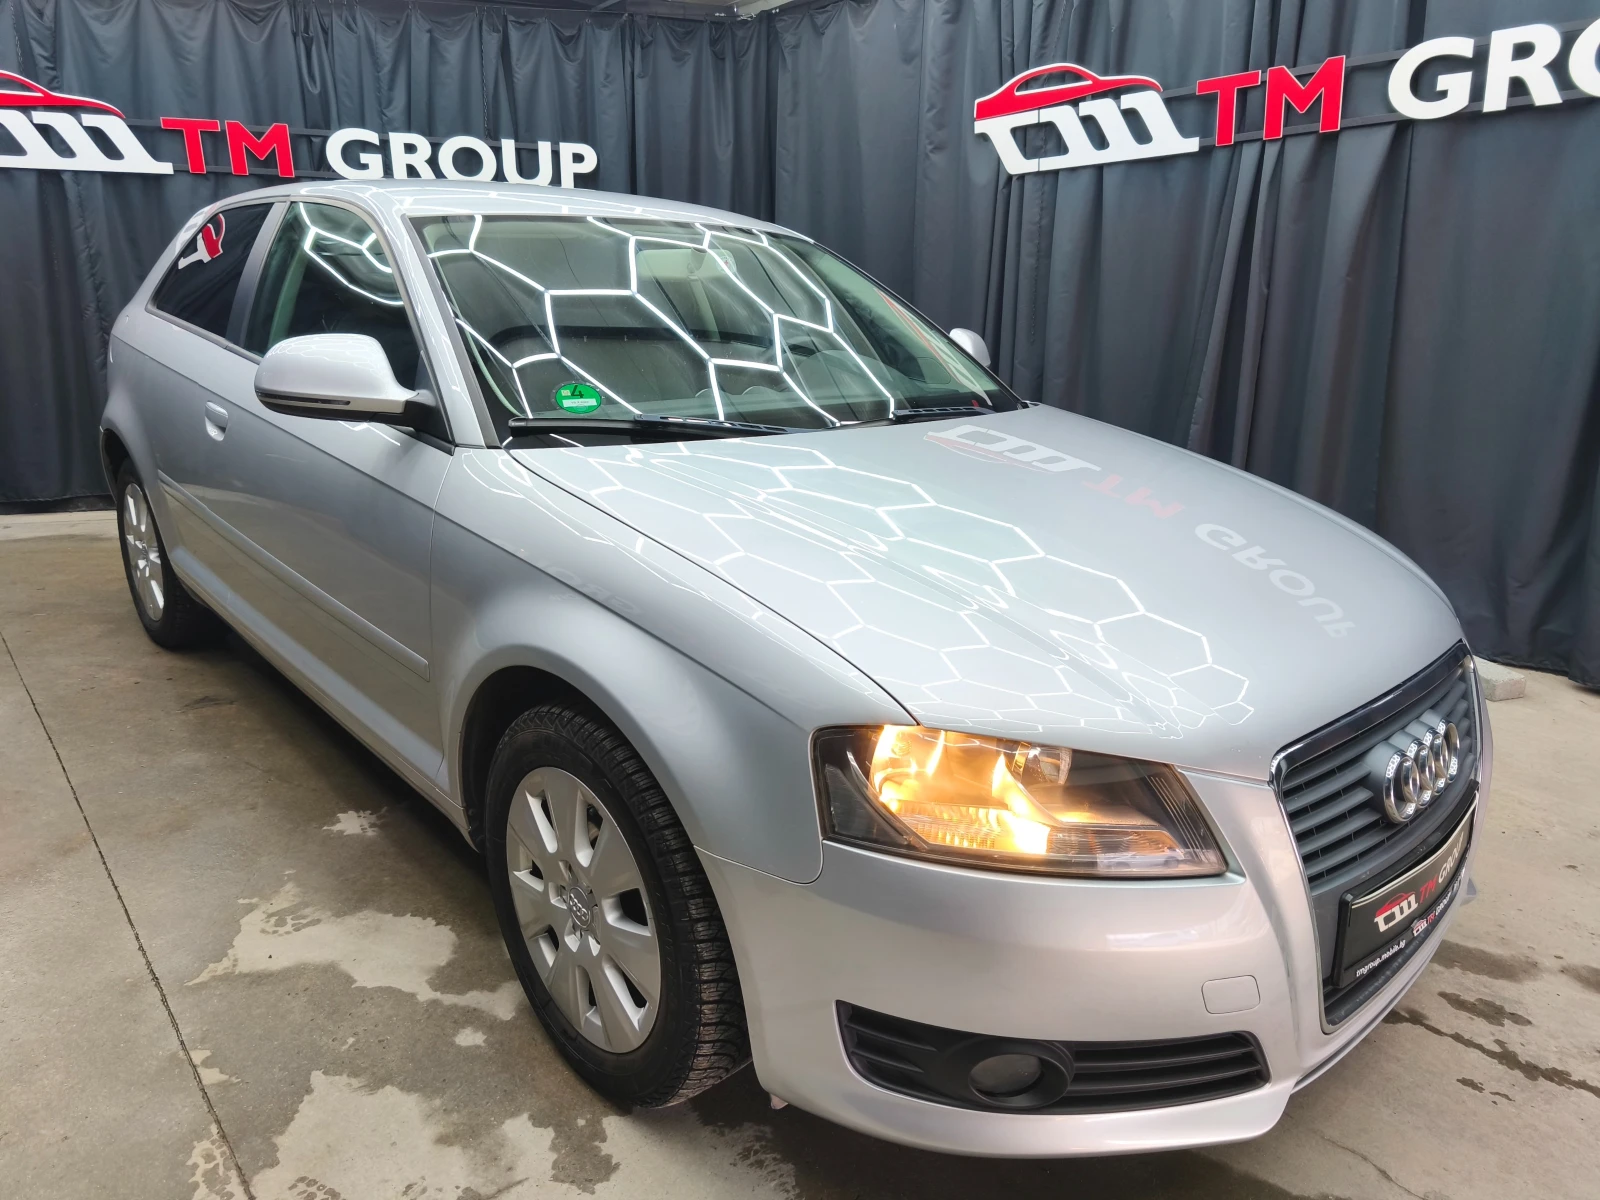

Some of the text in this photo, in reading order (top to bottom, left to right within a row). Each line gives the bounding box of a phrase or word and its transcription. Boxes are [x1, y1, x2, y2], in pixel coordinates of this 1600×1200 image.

[1196, 55, 1346, 147] TM
[160, 116, 598, 188] TM GROUP
[1419, 873, 1438, 904] TM
